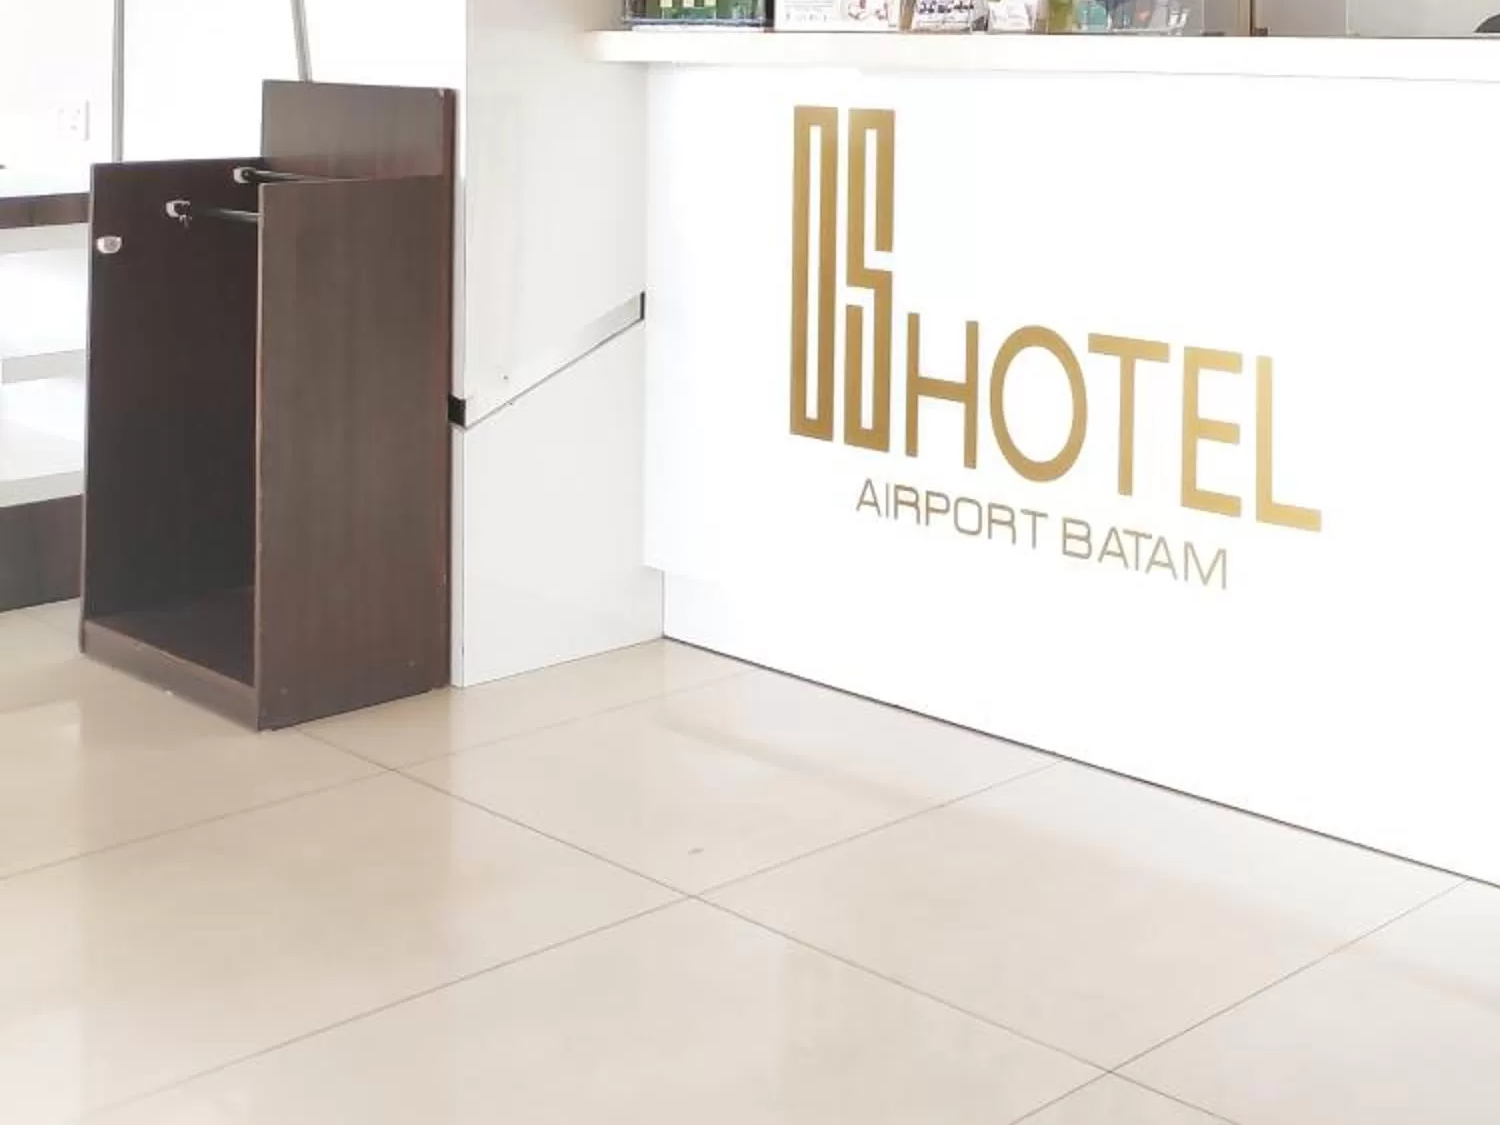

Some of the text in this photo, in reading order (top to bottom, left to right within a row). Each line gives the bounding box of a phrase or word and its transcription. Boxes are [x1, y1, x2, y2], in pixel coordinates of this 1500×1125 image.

[789, 104, 1321, 532] OS HOTEL
[855, 477, 1229, 590] AIRPORT BATAM
